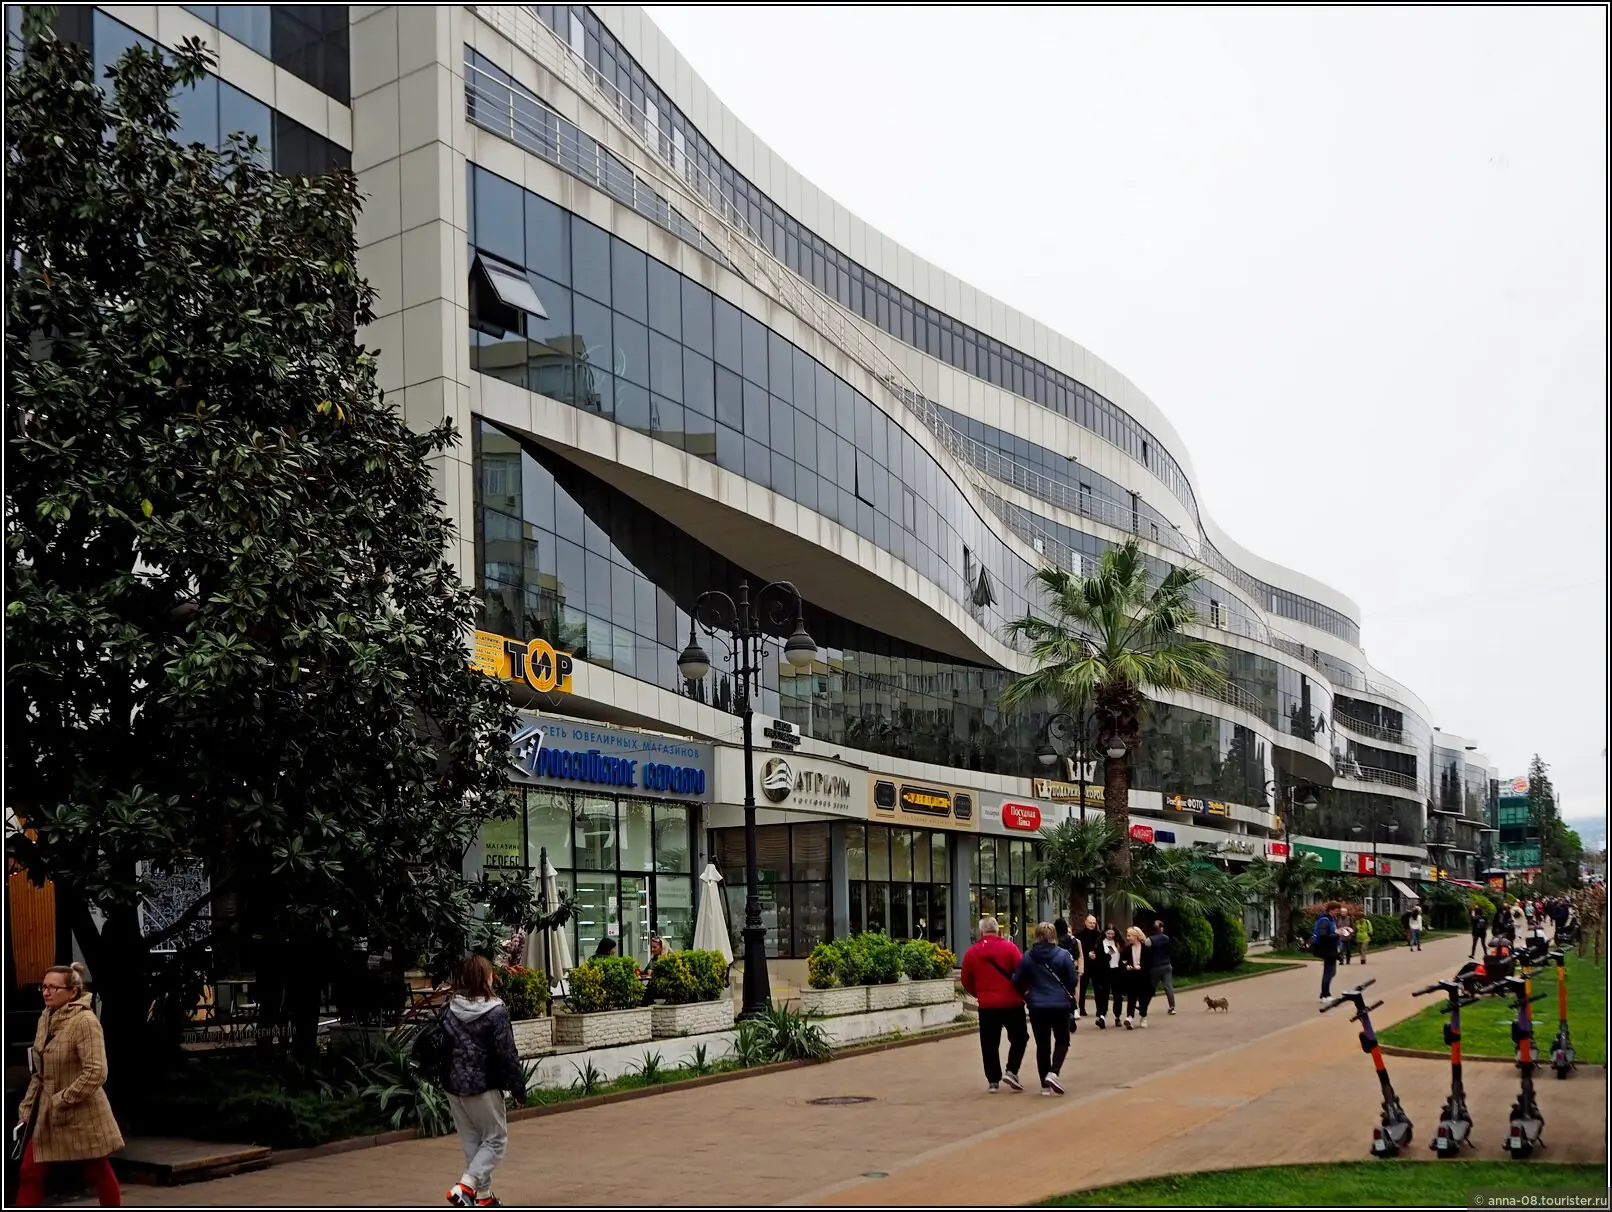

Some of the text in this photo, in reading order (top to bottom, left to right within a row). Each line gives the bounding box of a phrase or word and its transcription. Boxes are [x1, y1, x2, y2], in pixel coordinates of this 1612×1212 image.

[540, 725, 700, 759] СЕТЬ ЮВЕЛИРНЫХ МАГАЗИНОВ
[537, 747, 705, 794] РОССИЙСКОЕ СЕРЕБРО
[792, 770, 851, 800] АТРИУМ
